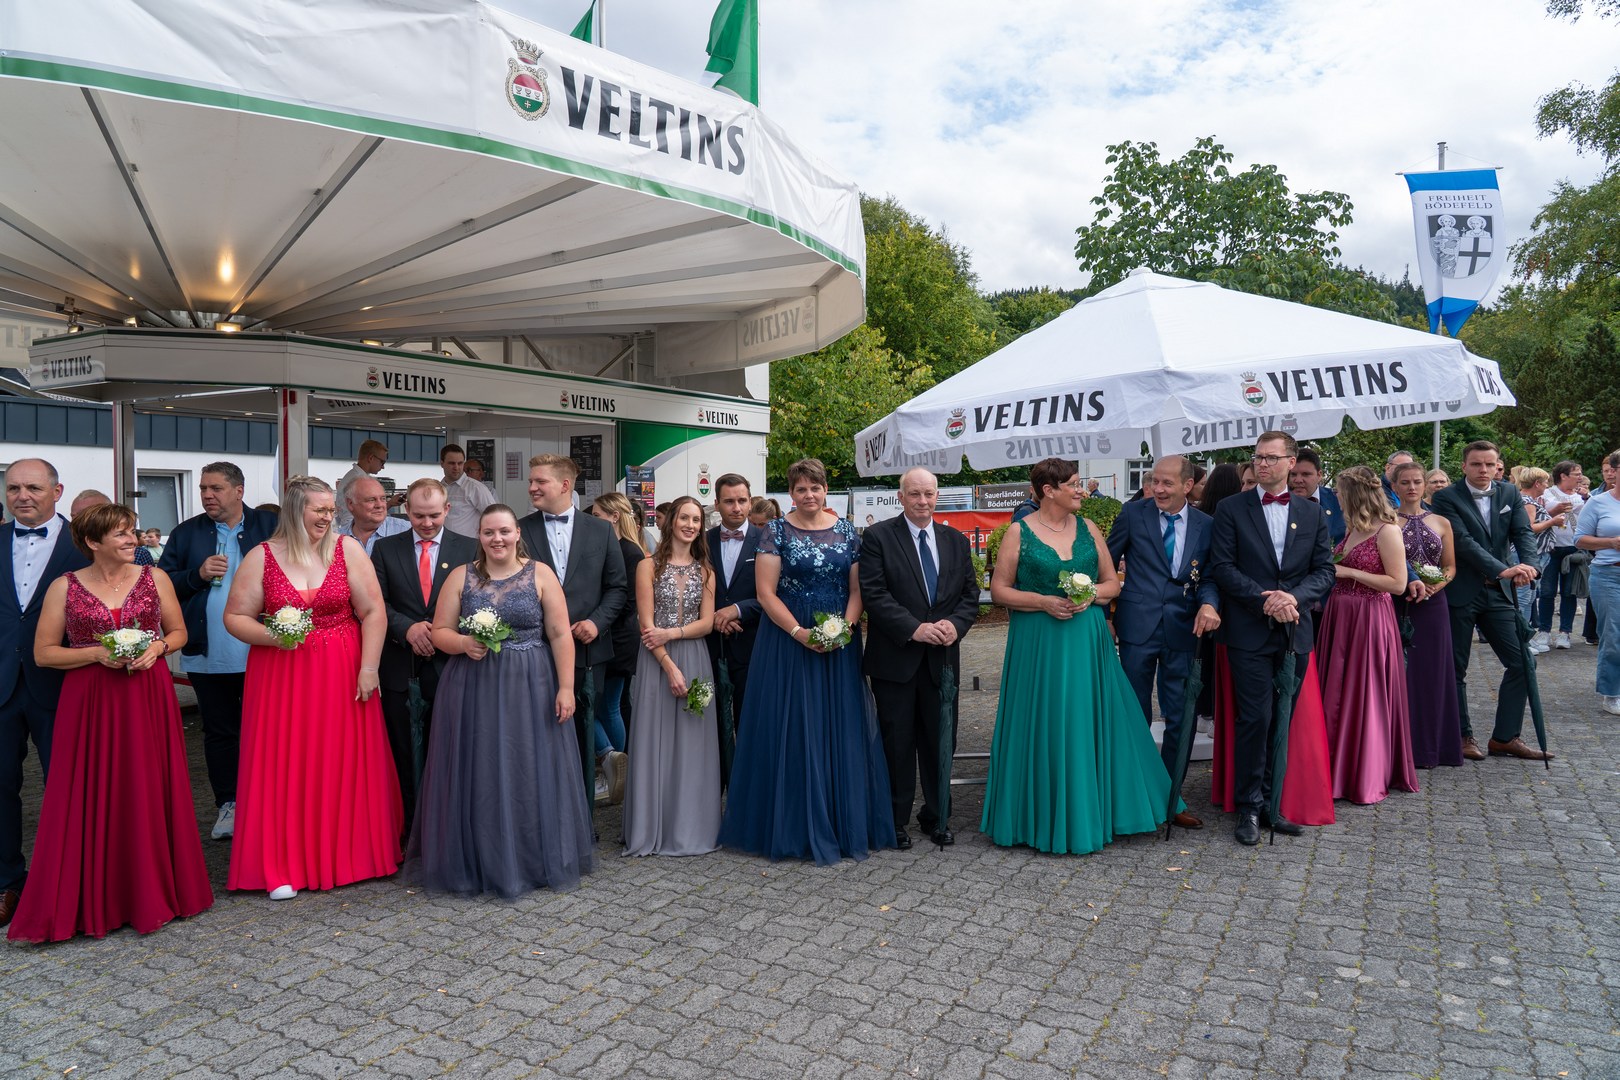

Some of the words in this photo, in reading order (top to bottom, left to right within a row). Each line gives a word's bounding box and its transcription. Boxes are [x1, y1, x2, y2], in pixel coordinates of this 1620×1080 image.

[560, 65, 746, 175] VELTINS
[1425, 201, 1493, 210] BÖDEFELD
[1428, 194, 1488, 202] FREIHEIT
[50, 355, 92, 379] VELTINS
[382, 371, 446, 395] VELTINS
[1266, 361, 1408, 402] VELTINS
[571, 394, 616, 413] VELTINS
[974, 390, 1105, 433] VELTINS
[705, 410, 739, 426] VELTINS
[984, 490, 1025, 499] Sauerländer.
